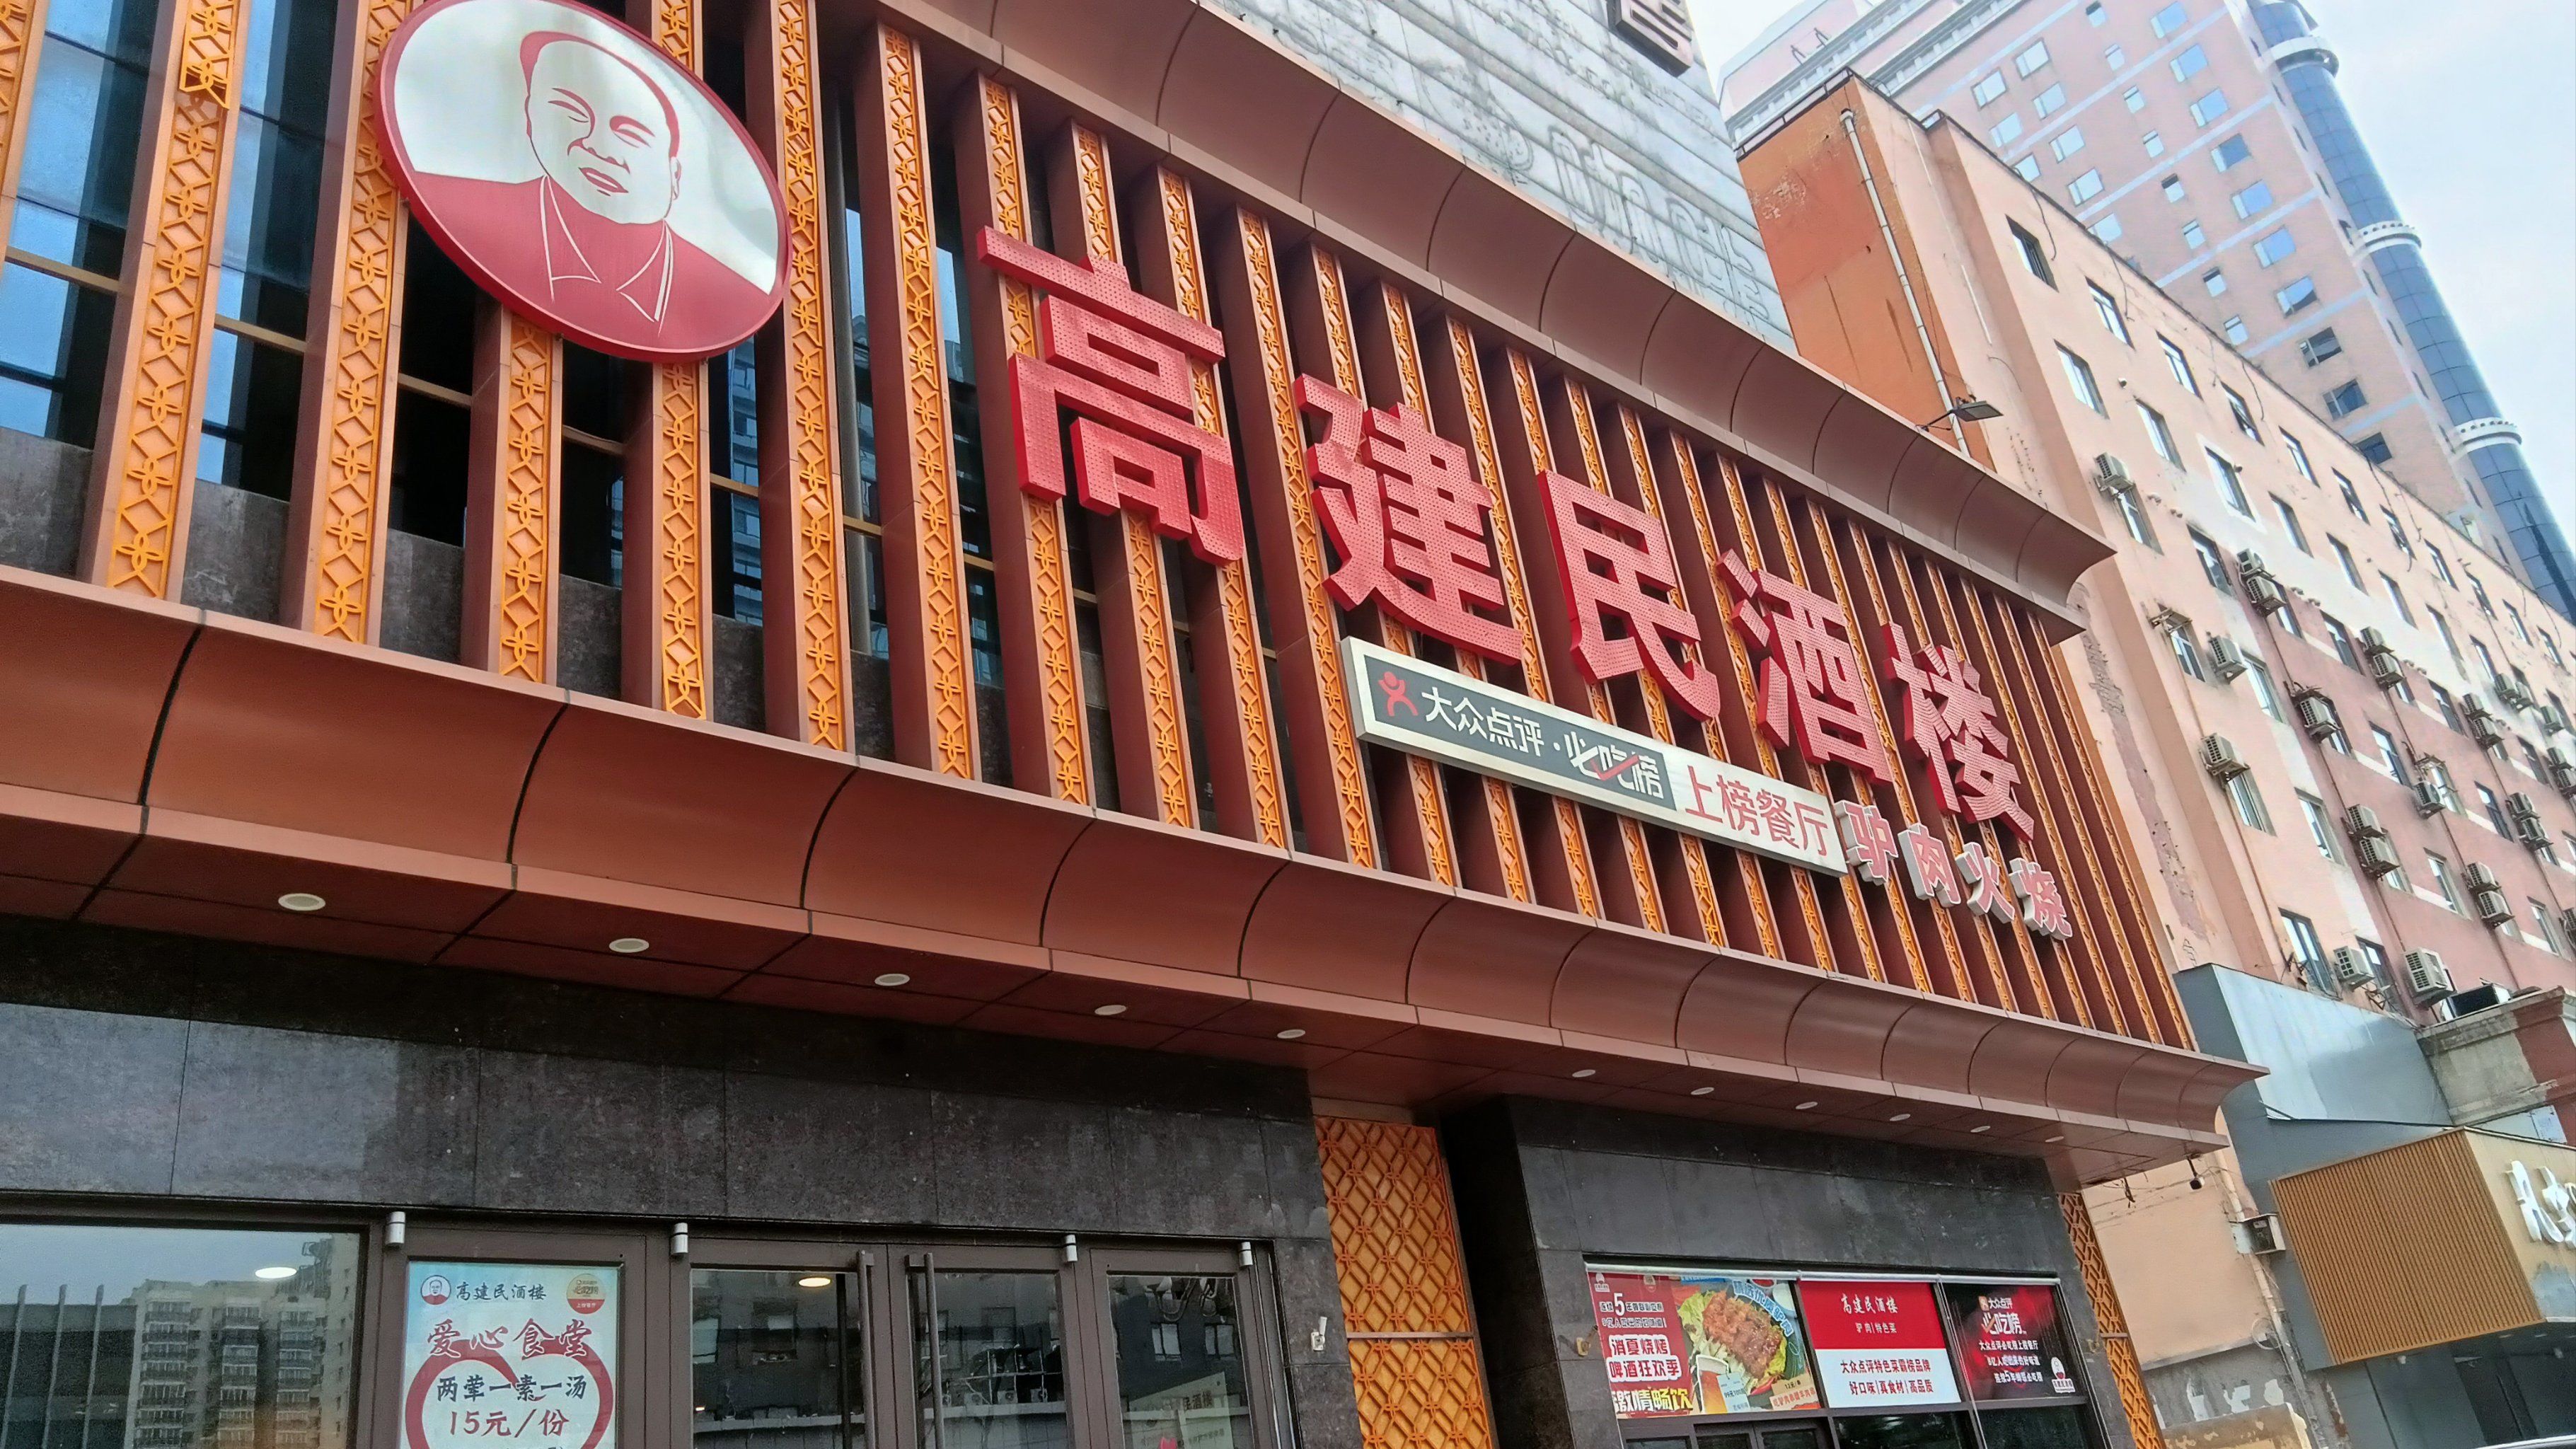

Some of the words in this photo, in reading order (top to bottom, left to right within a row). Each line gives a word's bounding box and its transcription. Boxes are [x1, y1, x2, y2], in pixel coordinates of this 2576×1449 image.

[977, 226, 2035, 842] 高建民酒楼
[1685, 766, 1829, 857] 上榜餐厅
[1835, 799, 2074, 940] 驴肉火烧
[456, 1281, 546, 1301] 高建民酒楼
[1988, 1297, 2013, 1309] 大众点评
[1841, 1293, 1898, 1314] 高建民酒楼
[427, 1318, 592, 1361] 爱心食堂
[1611, 1338, 1668, 1356] 消夏烧烤
[1609, 1358, 1680, 1378] 啤酒狂欢季
[1840, 1358, 1931, 1373] 大众点评特色菜霸榜品牌
[437, 1374, 587, 1402] 两荤一素一汤
[1612, 1388, 1693, 1412] 激情畅饮
[451, 1408, 570, 1438] 15元/份
